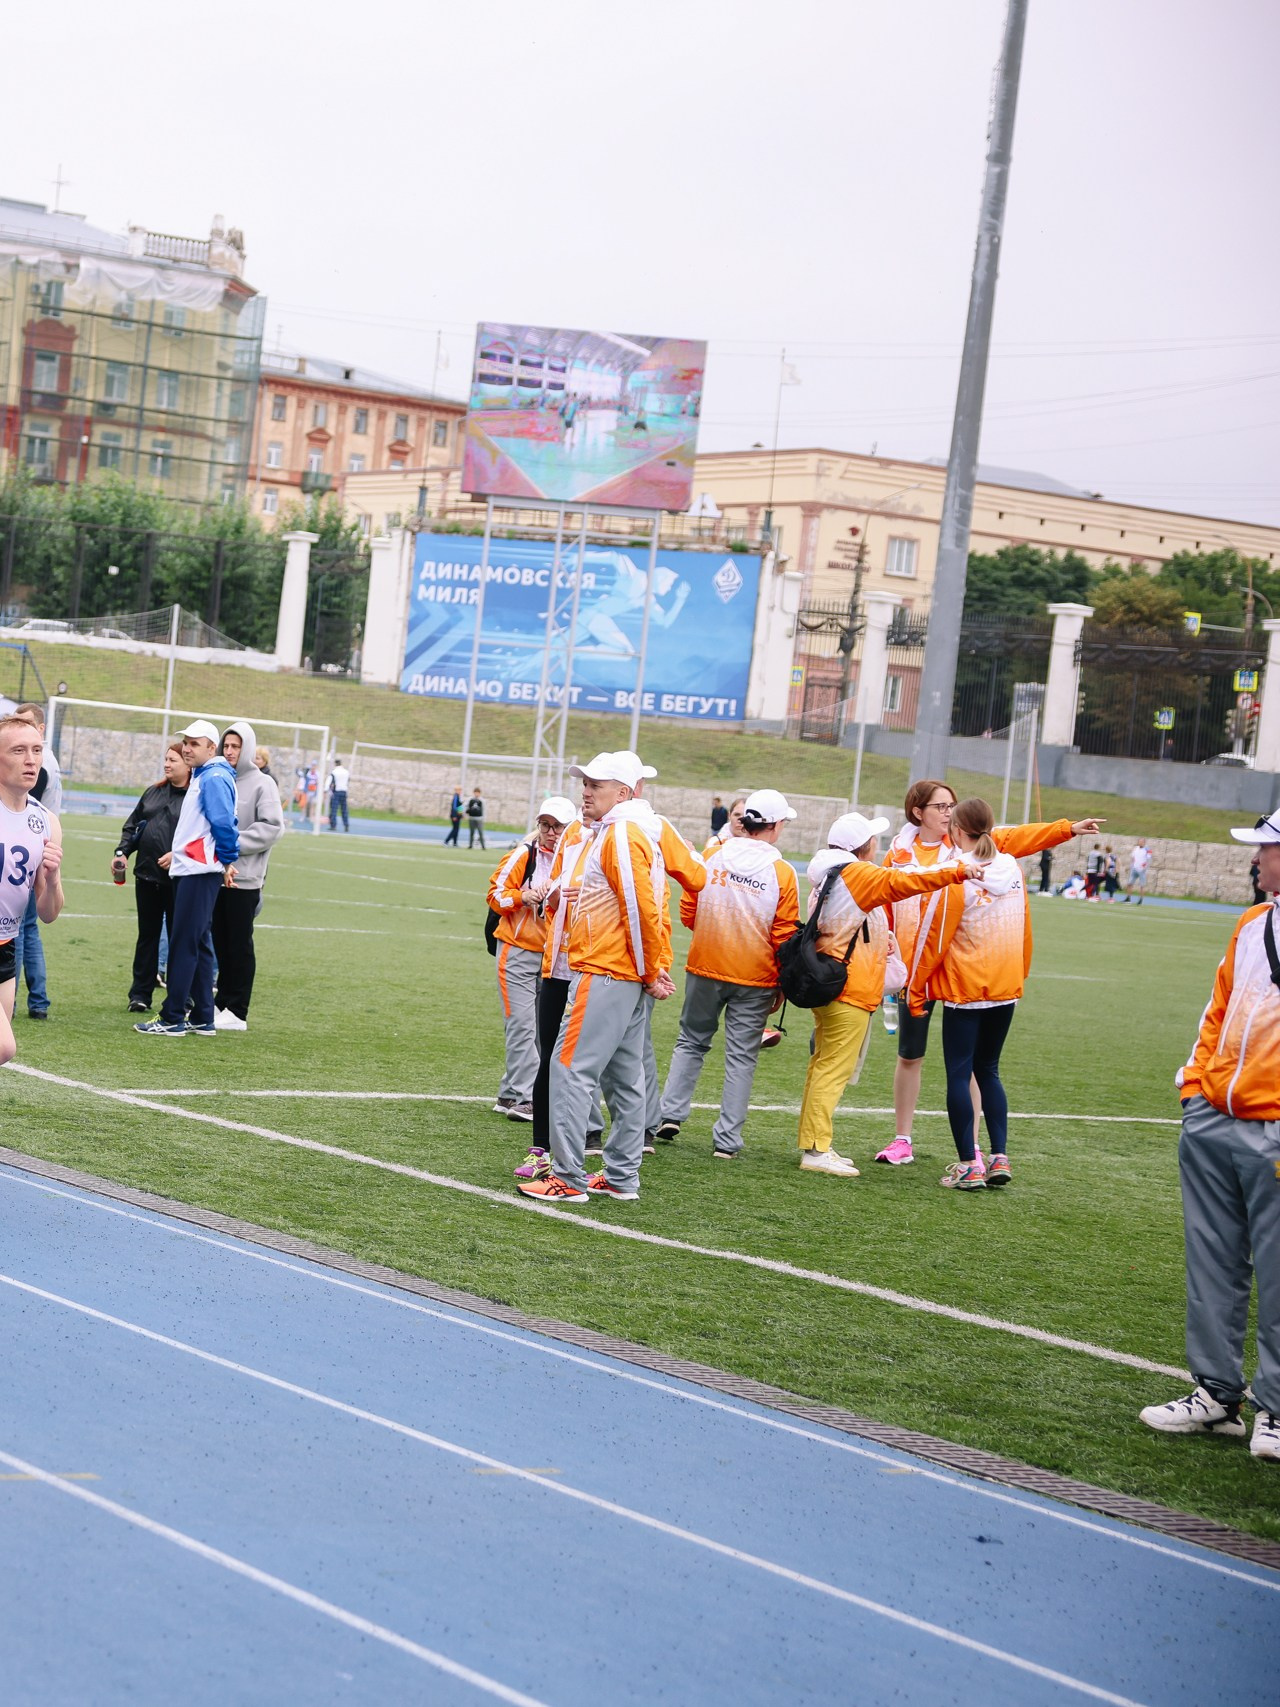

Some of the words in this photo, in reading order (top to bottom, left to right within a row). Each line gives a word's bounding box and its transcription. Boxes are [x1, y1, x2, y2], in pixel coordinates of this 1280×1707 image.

[417, 584, 480, 605] МИЛЯ
[407, 673, 503, 698] ДИНАМО
[614, 690, 656, 711] ВСЕ
[660, 693, 738, 717] БЕГУТ!
[730, 873, 767, 891] КОМОС
